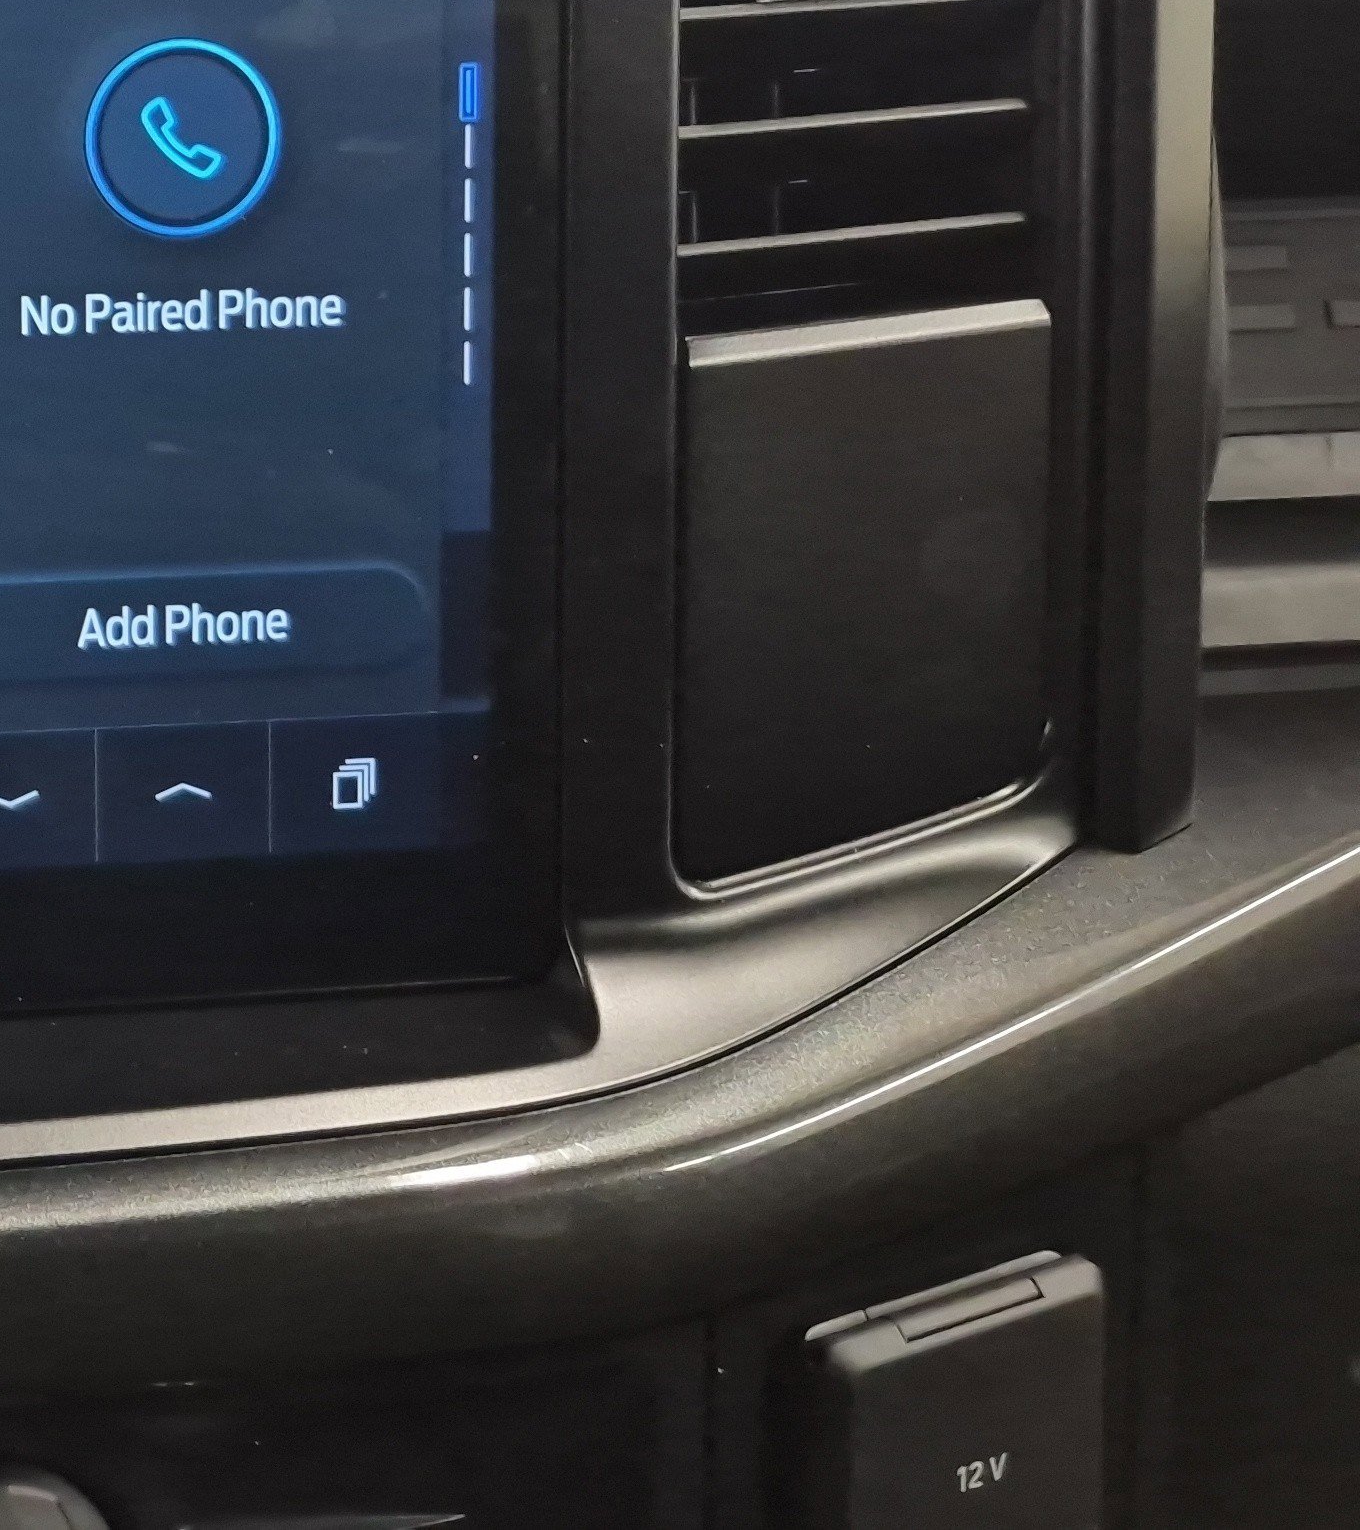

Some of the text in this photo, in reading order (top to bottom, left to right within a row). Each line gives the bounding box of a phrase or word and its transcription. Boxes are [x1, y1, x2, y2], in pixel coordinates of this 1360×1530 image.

[19, 287, 346, 337] No Paired Phone
[77, 602, 291, 650] Add Phone
[956, 1452, 1008, 1492] 12 V
